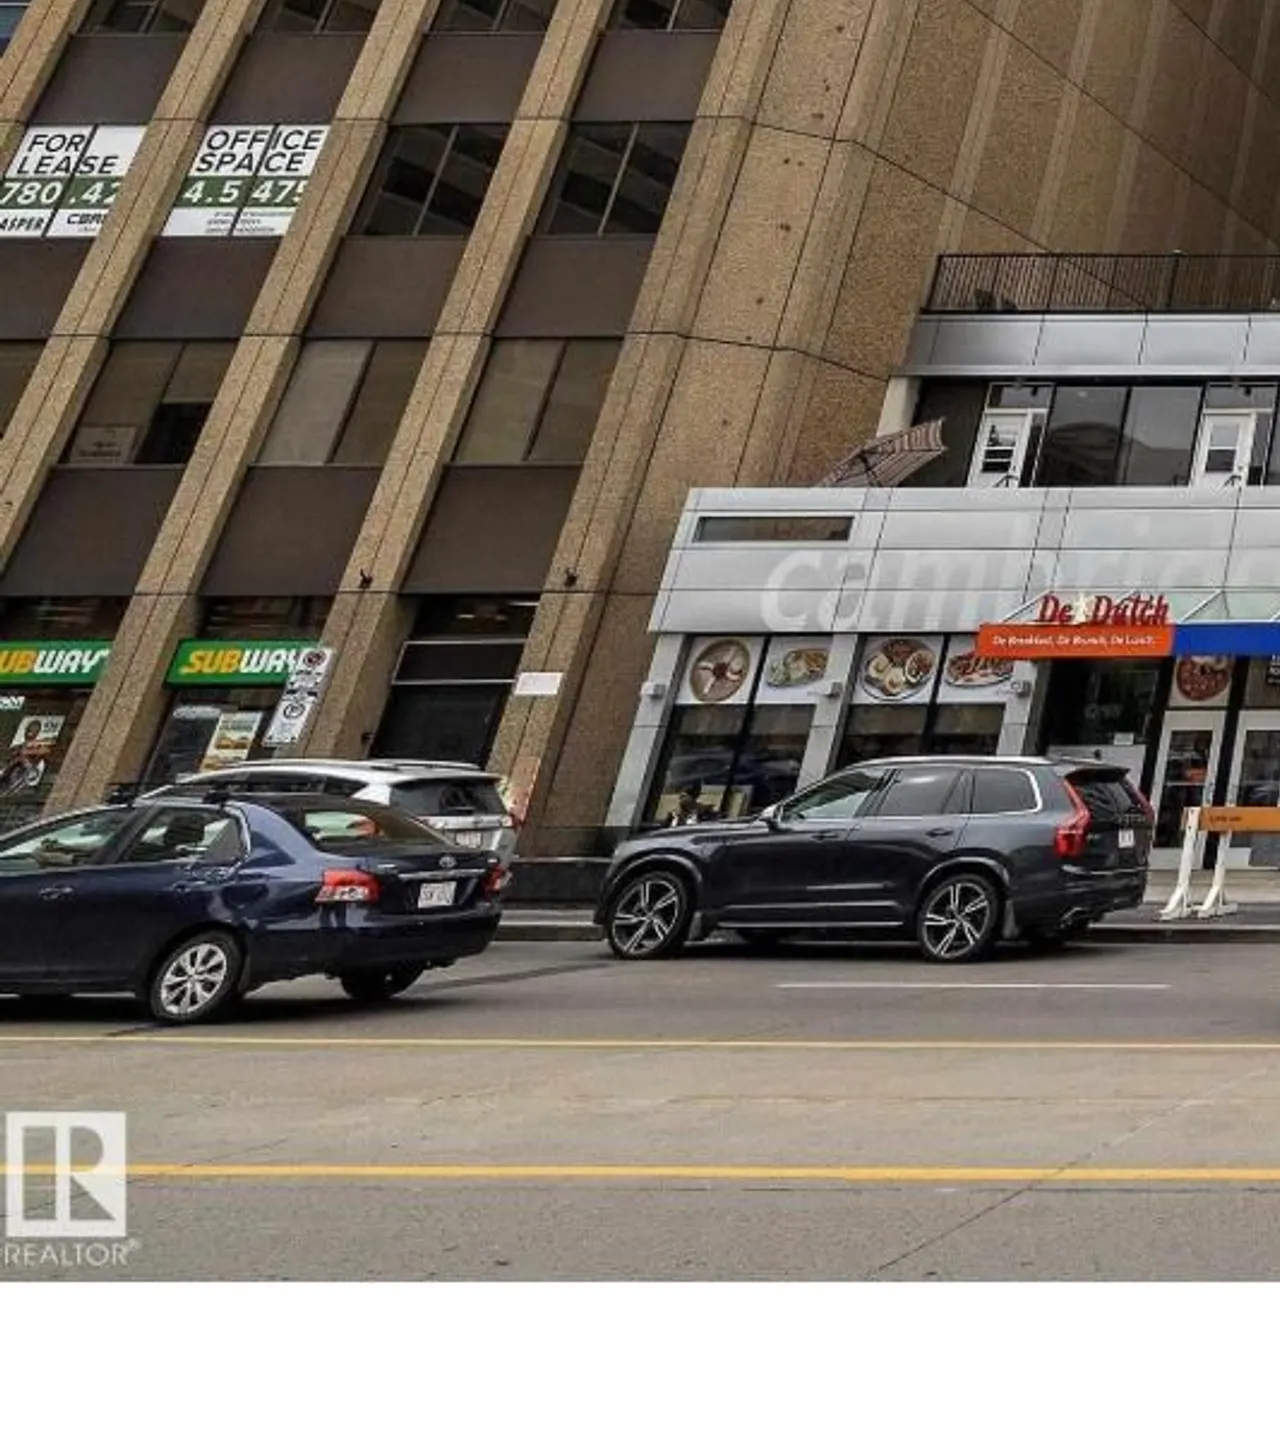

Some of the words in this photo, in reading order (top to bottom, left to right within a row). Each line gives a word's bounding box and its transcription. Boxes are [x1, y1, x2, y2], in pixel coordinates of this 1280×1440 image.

[27, 134, 85, 153] FOR
[206, 129, 325, 151] OFFICE
[17, 156, 119, 174] LEASE
[196, 152, 307, 172] SPACE
[1035, 593, 1074, 623] De
[1091, 593, 1170, 626] Dutch
